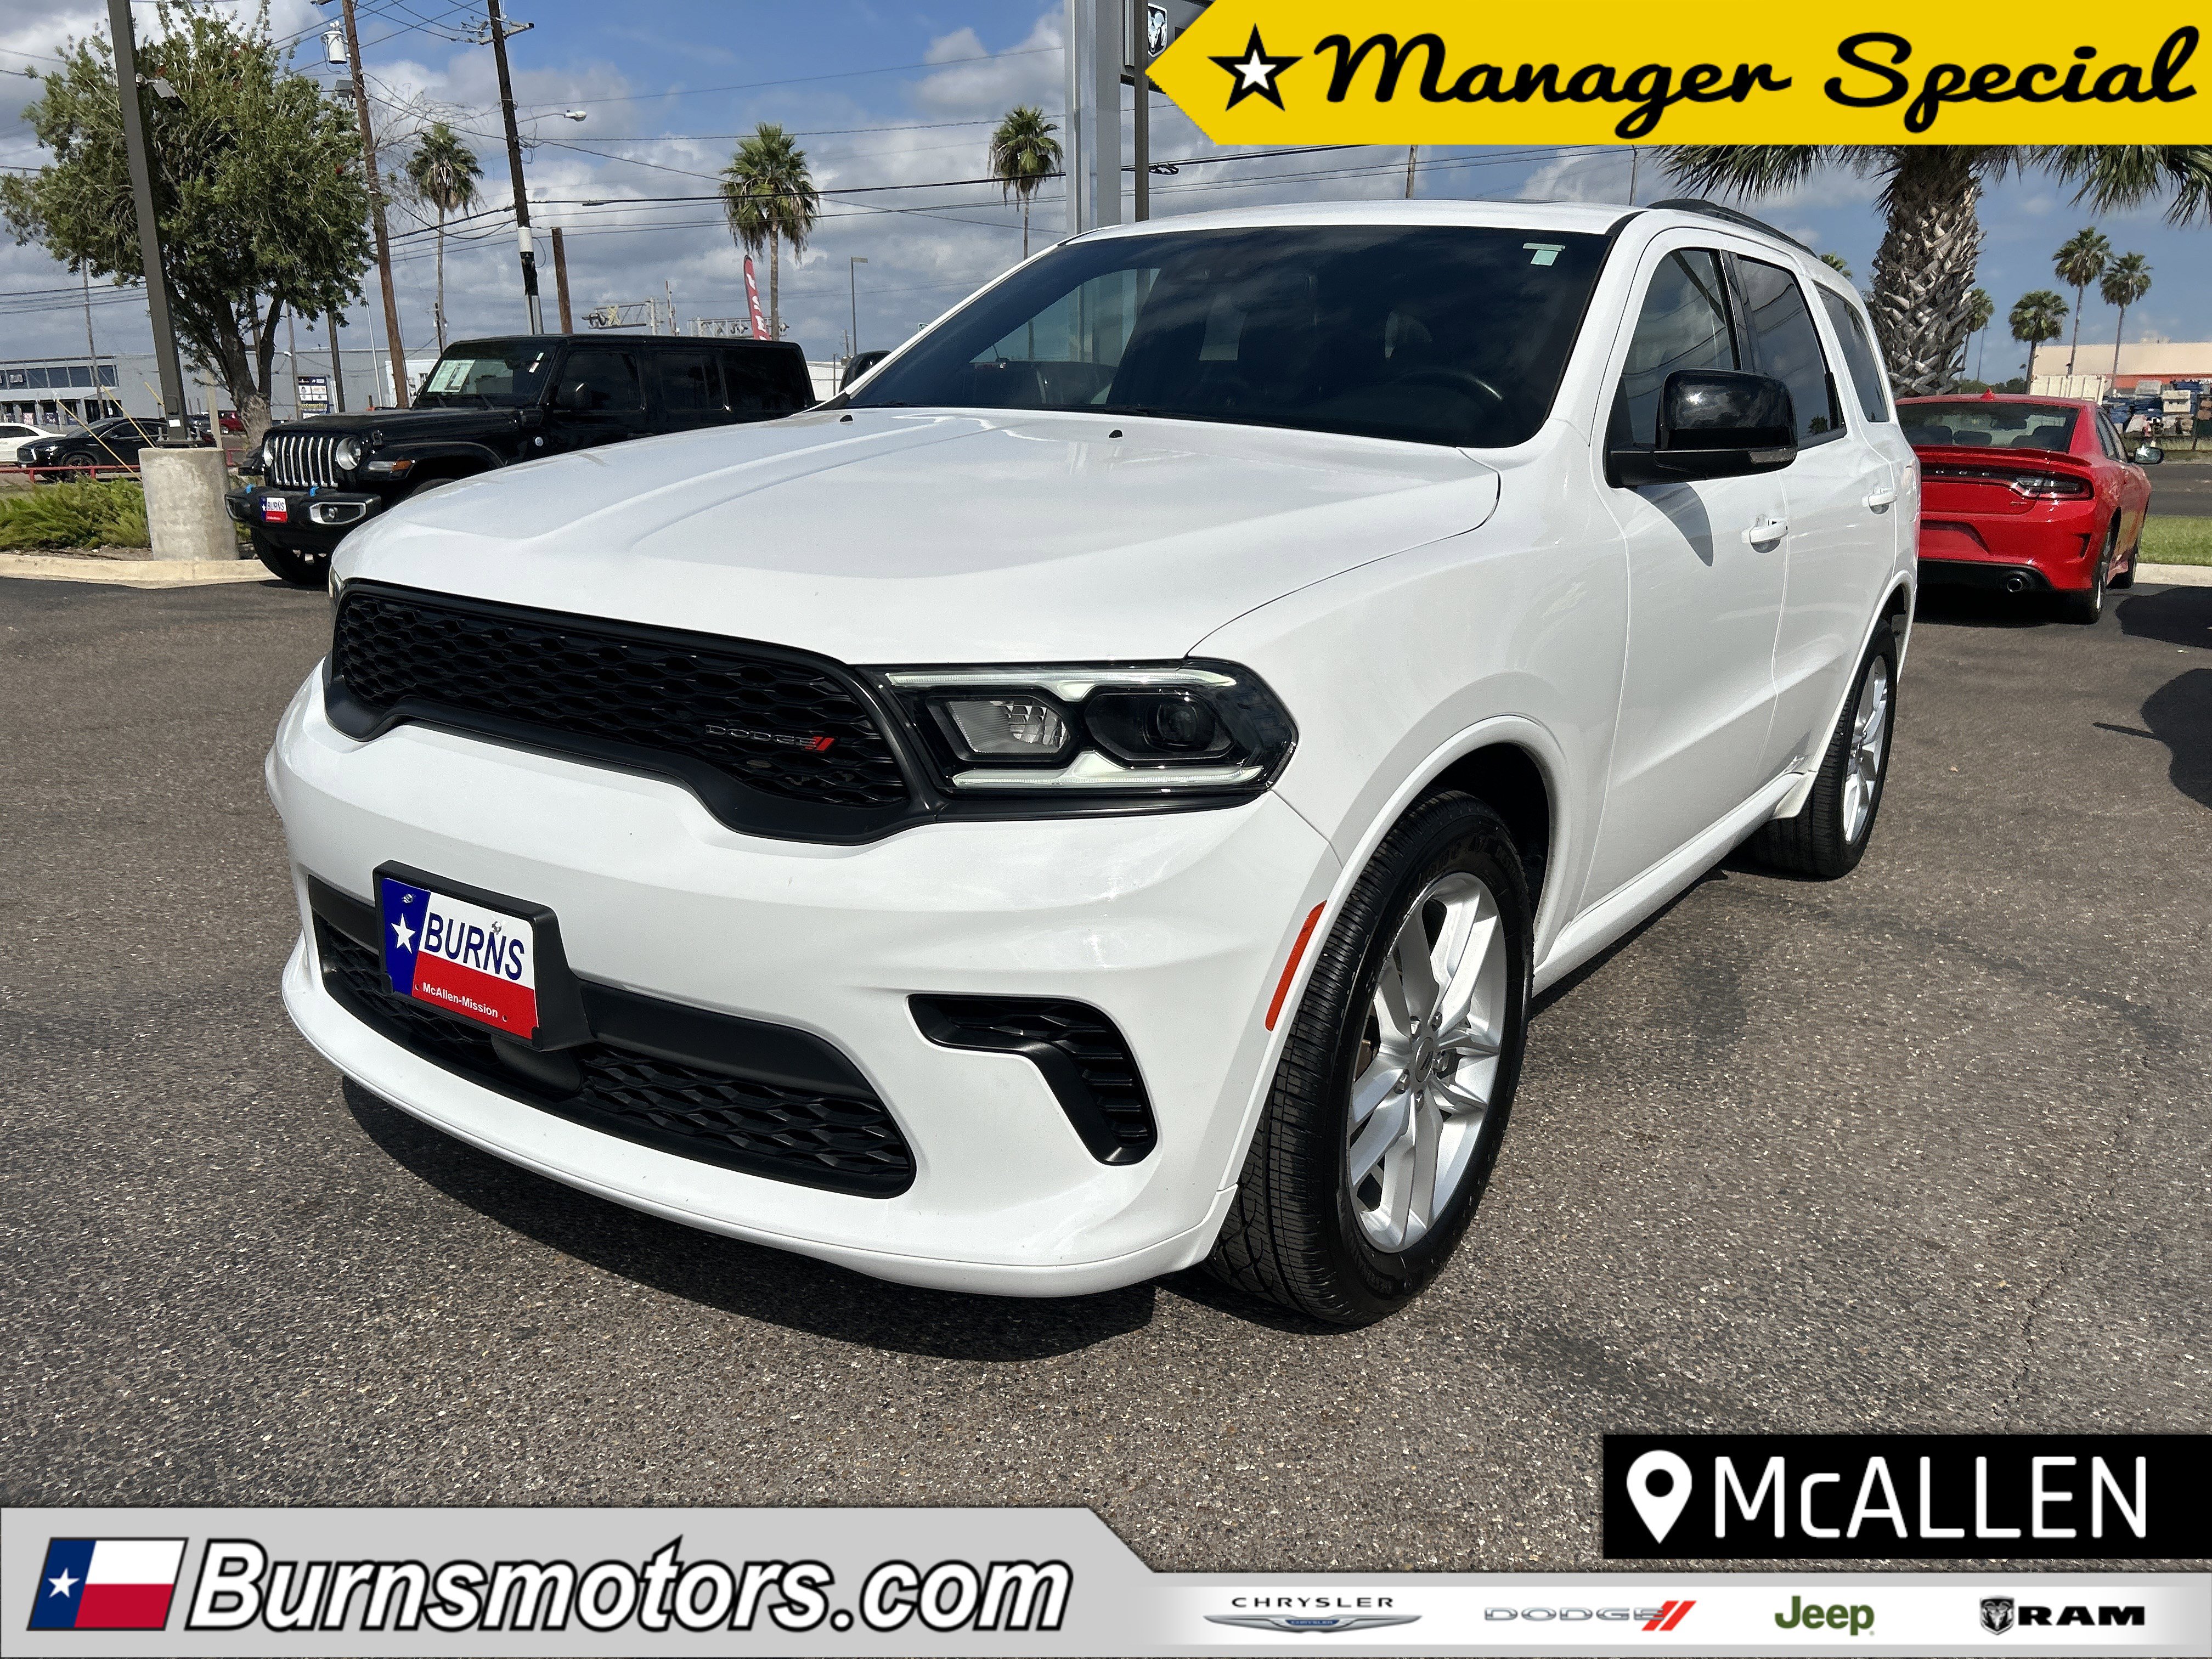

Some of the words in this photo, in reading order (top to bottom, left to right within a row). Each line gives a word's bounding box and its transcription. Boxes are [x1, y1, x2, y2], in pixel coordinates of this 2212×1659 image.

[267, 501, 285, 511] BURNS
[706, 724, 817, 747] DODGE
[424, 912, 524, 980] BURNS
[422, 981, 499, 1018] McAllen-Mission
